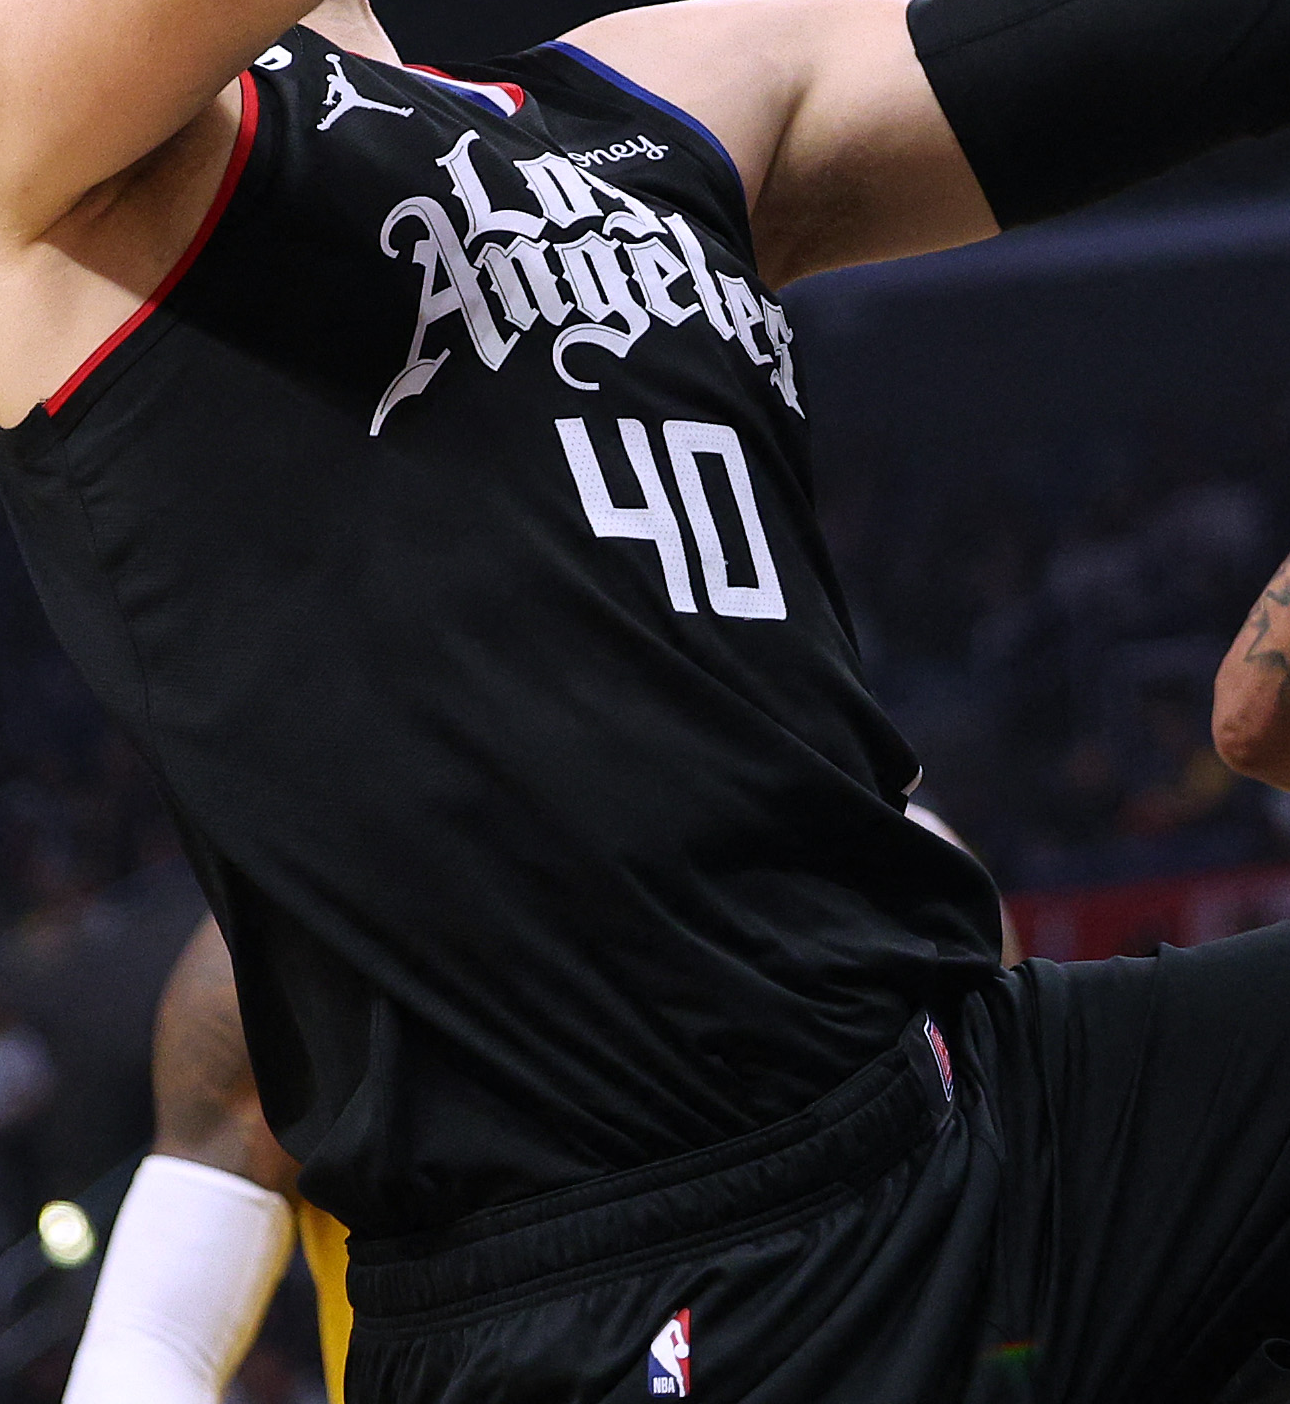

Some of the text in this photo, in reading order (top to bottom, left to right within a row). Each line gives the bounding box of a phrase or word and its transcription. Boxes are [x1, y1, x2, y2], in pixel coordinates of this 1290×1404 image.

[435, 129, 668, 250] Los
[567, 134, 670, 168] oney
[369, 195, 807, 438] Angeles
[554, 417, 788, 621] 40
[652, 1376, 676, 1394] NBA
